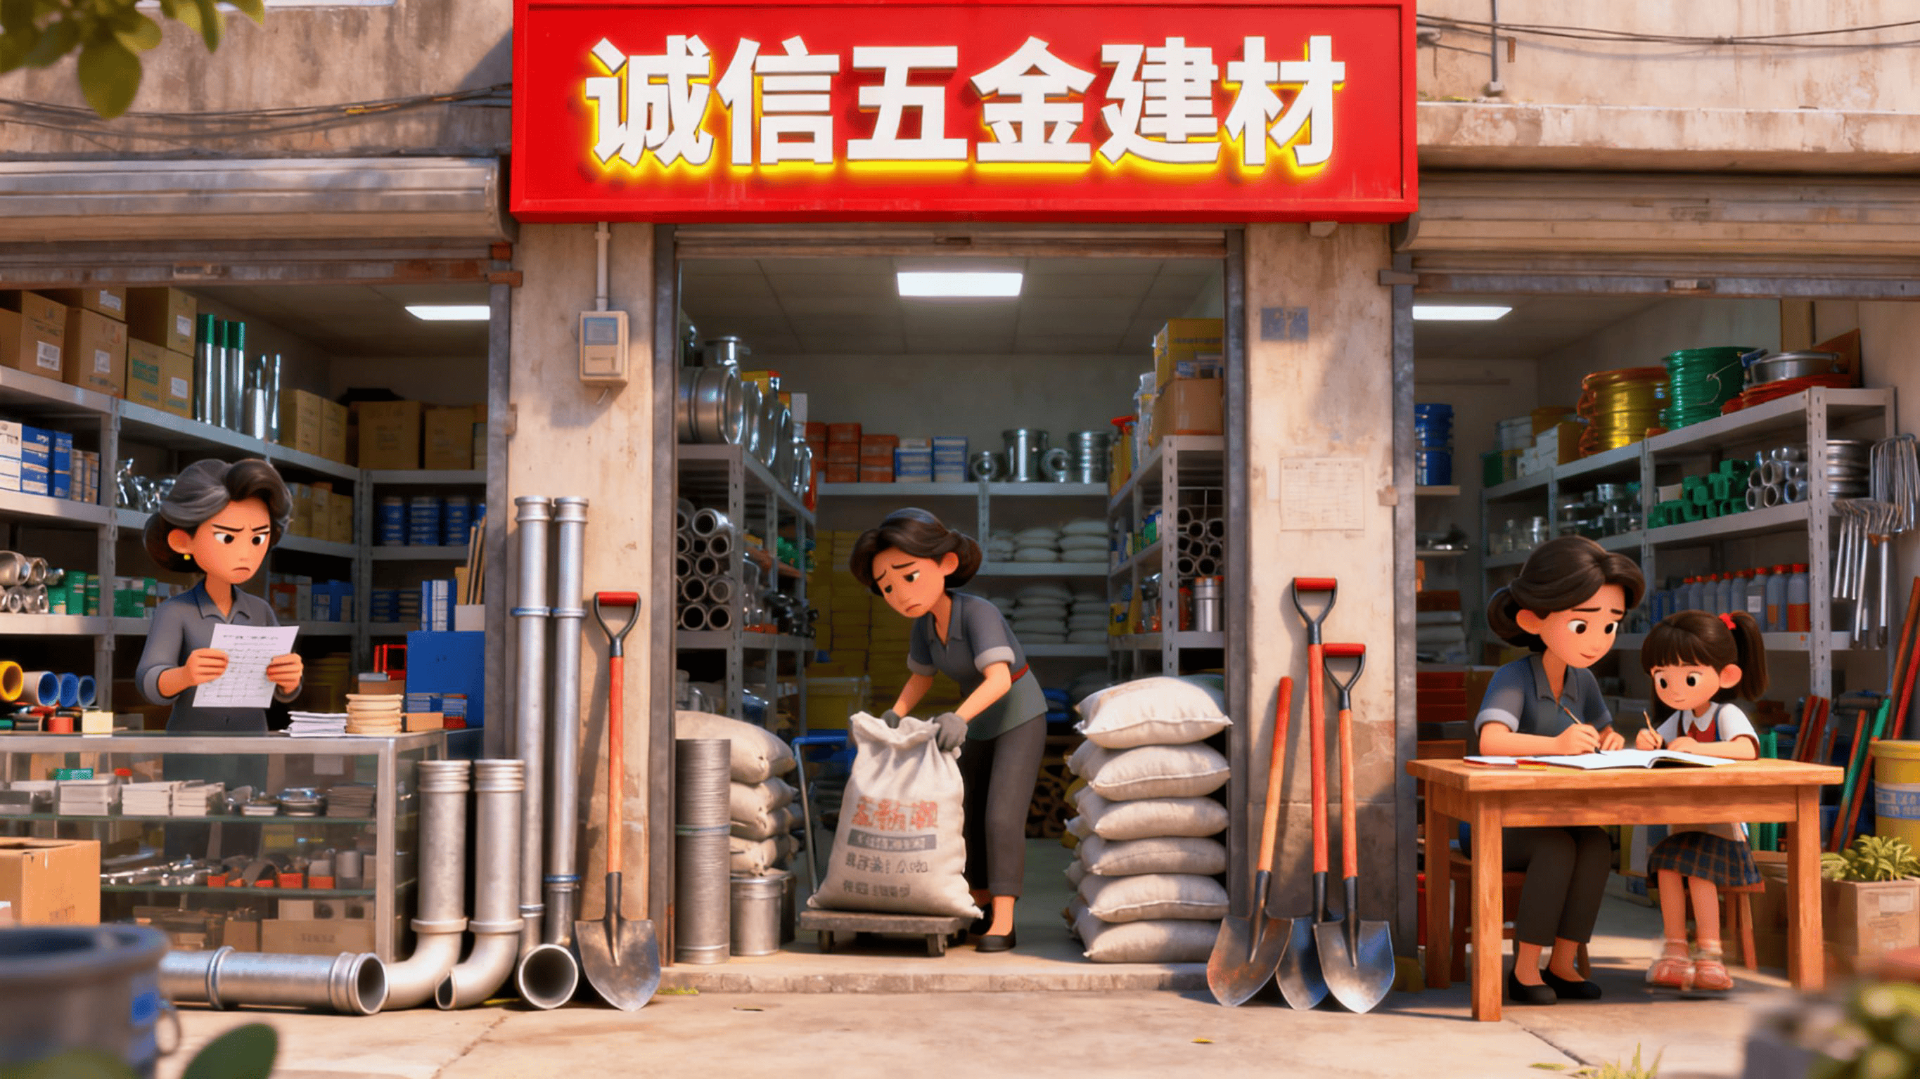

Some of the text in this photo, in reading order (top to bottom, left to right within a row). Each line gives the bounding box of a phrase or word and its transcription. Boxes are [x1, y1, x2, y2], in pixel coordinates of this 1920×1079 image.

[586, 35, 1346, 167] 诚信五金建材
